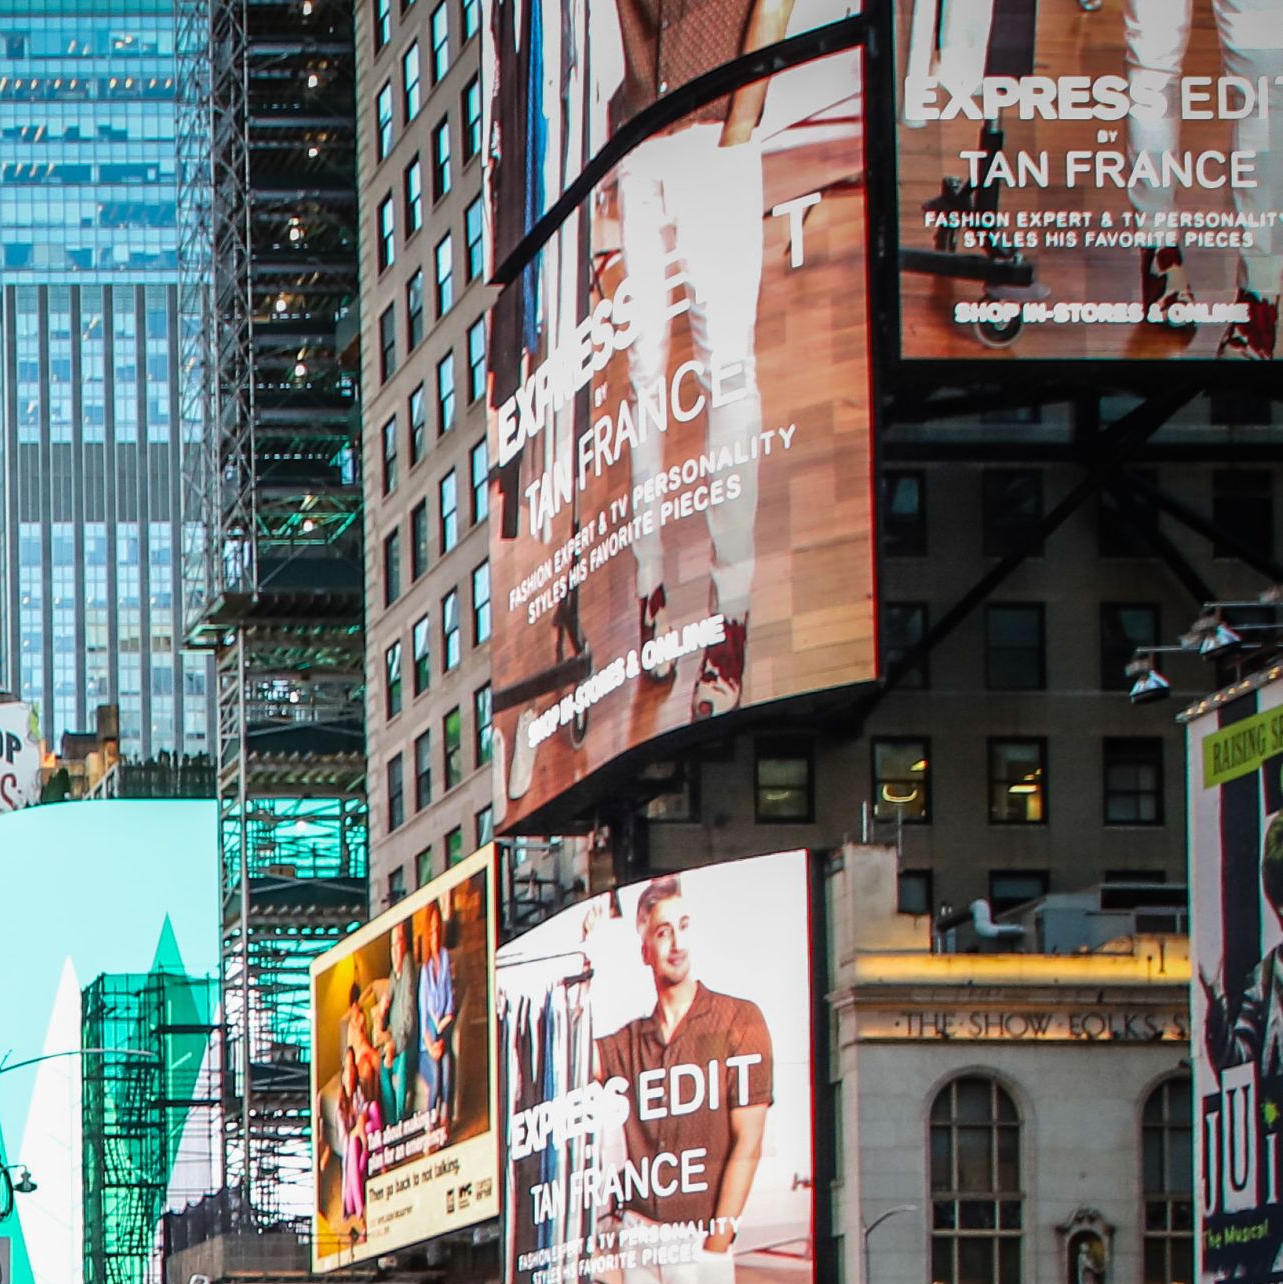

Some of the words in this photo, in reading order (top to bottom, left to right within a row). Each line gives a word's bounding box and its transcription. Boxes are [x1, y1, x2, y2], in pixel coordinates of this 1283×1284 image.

[904, 76, 1168, 121] EXPRESS
[1181, 76, 1283, 120] EDI
[1096, 130, 1119, 143] BY
[960, 150, 1049, 188] TAN
[1066, 150, 1258, 188] FRANCE
[924, 211, 1010, 228] FASHION
[1017, 211, 1093, 228] EXPERT
[1101, 211, 1113, 228] &
[1122, 212, 1147, 228] TV
[963, 231, 1039, 248] STYLES
[1045, 231, 1078, 248] HIS
[1085, 231, 1178, 248] FAVORITE
[1184, 231, 1255, 248] PIECES
[954, 303, 1021, 323] SHOP
[1023, 303, 1144, 323] IN-STORES
[1147, 303, 1165, 323] &
[1168, 303, 1251, 323] ONLINE
[498, 276, 639, 468] EXPRESS
[594, 381, 609, 408] BY
[525, 460, 572, 536] TAN
[578, 357, 755, 491] FRANCE
[509, 559, 553, 611] FASHION
[553, 524, 595, 573] EXPERT
[610, 494, 629, 518] TV
[633, 424, 796, 510] PERSONALITY
[528, 576, 568, 625] STYLES
[568, 558, 587, 590] HIS
[590, 515, 653, 575] FAVORITE
[660, 474, 742, 526] PIECES
[1213, 723, 1266, 776] RAISING
[899, 1012, 954, 1036] THE
[969, 1012, 1052, 1036] SHOW
[511, 1076, 631, 1161] EXPRESS
[639, 1053, 763, 1121] EDIT
[368, 1186, 383, 1202] Then
[395, 1176, 411, 1193] back
[421, 1167, 433, 1182] not
[530, 1179, 566, 1226] TAN
[570, 1148, 708, 1213] FRANCE
[599, 1232, 615, 1249] TV
[619, 1215, 744, 1247] PERSONALITY
[1224, 1218, 1269, 1245] Musical
